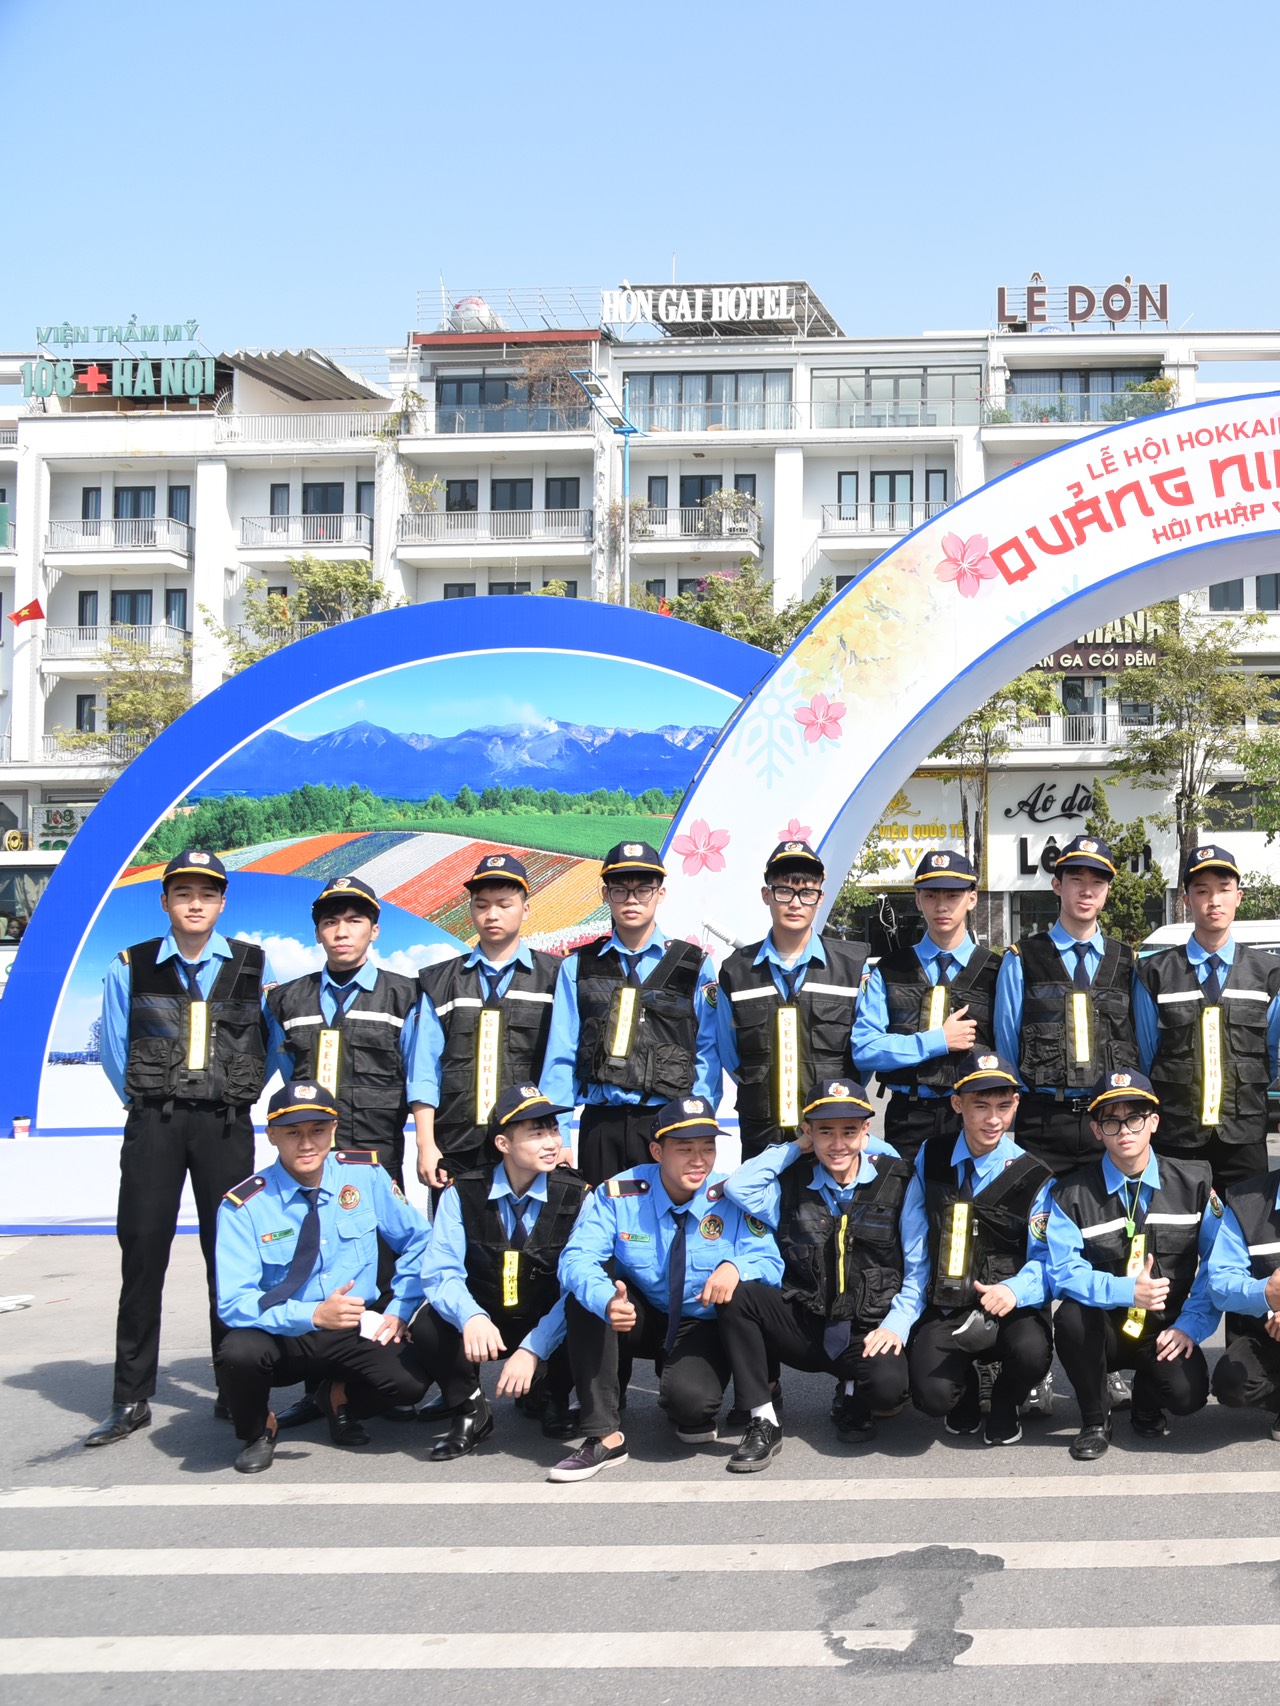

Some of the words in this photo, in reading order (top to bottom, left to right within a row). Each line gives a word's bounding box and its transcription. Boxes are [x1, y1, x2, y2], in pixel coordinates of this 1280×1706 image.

[601, 279, 654, 323] HÒN
[658, 288, 705, 323] GAI
[710, 286, 795, 321] HOTEL
[997, 272, 1047, 323] LÊ
[36, 321, 89, 348] VIỆN
[93, 313, 159, 344] THẨM
[163, 319, 199, 342] MỸ
[20, 360, 75, 397] 108
[112, 351, 156, 397] HÀ
[161, 350, 215, 404] NỘI
[1086, 445, 1119, 480] LỄ
[1123, 437, 1170, 467] HỘI
[988, 466, 1195, 586] QUẢNG
[1152, 518, 1192, 544] HỘI
[1196, 502, 1265, 534] NHẬP
[1060, 654, 1084, 668] GA
[1088, 648, 1119, 668] GỐI
[1124, 650, 1157, 667] ĐÊM
[1060, 784, 1095, 813] dà
[879, 821, 909, 842] VIỆN
[912, 817, 948, 841] QUỐC
[1019, 836, 1062, 876] Lê
[323, 1039, 333, 1091] SECU
[485, 1019, 493, 1110] SECURITY
[784, 1017, 793, 1110] SECURITY
[1208, 1022, 1217, 1114] SECURITY
